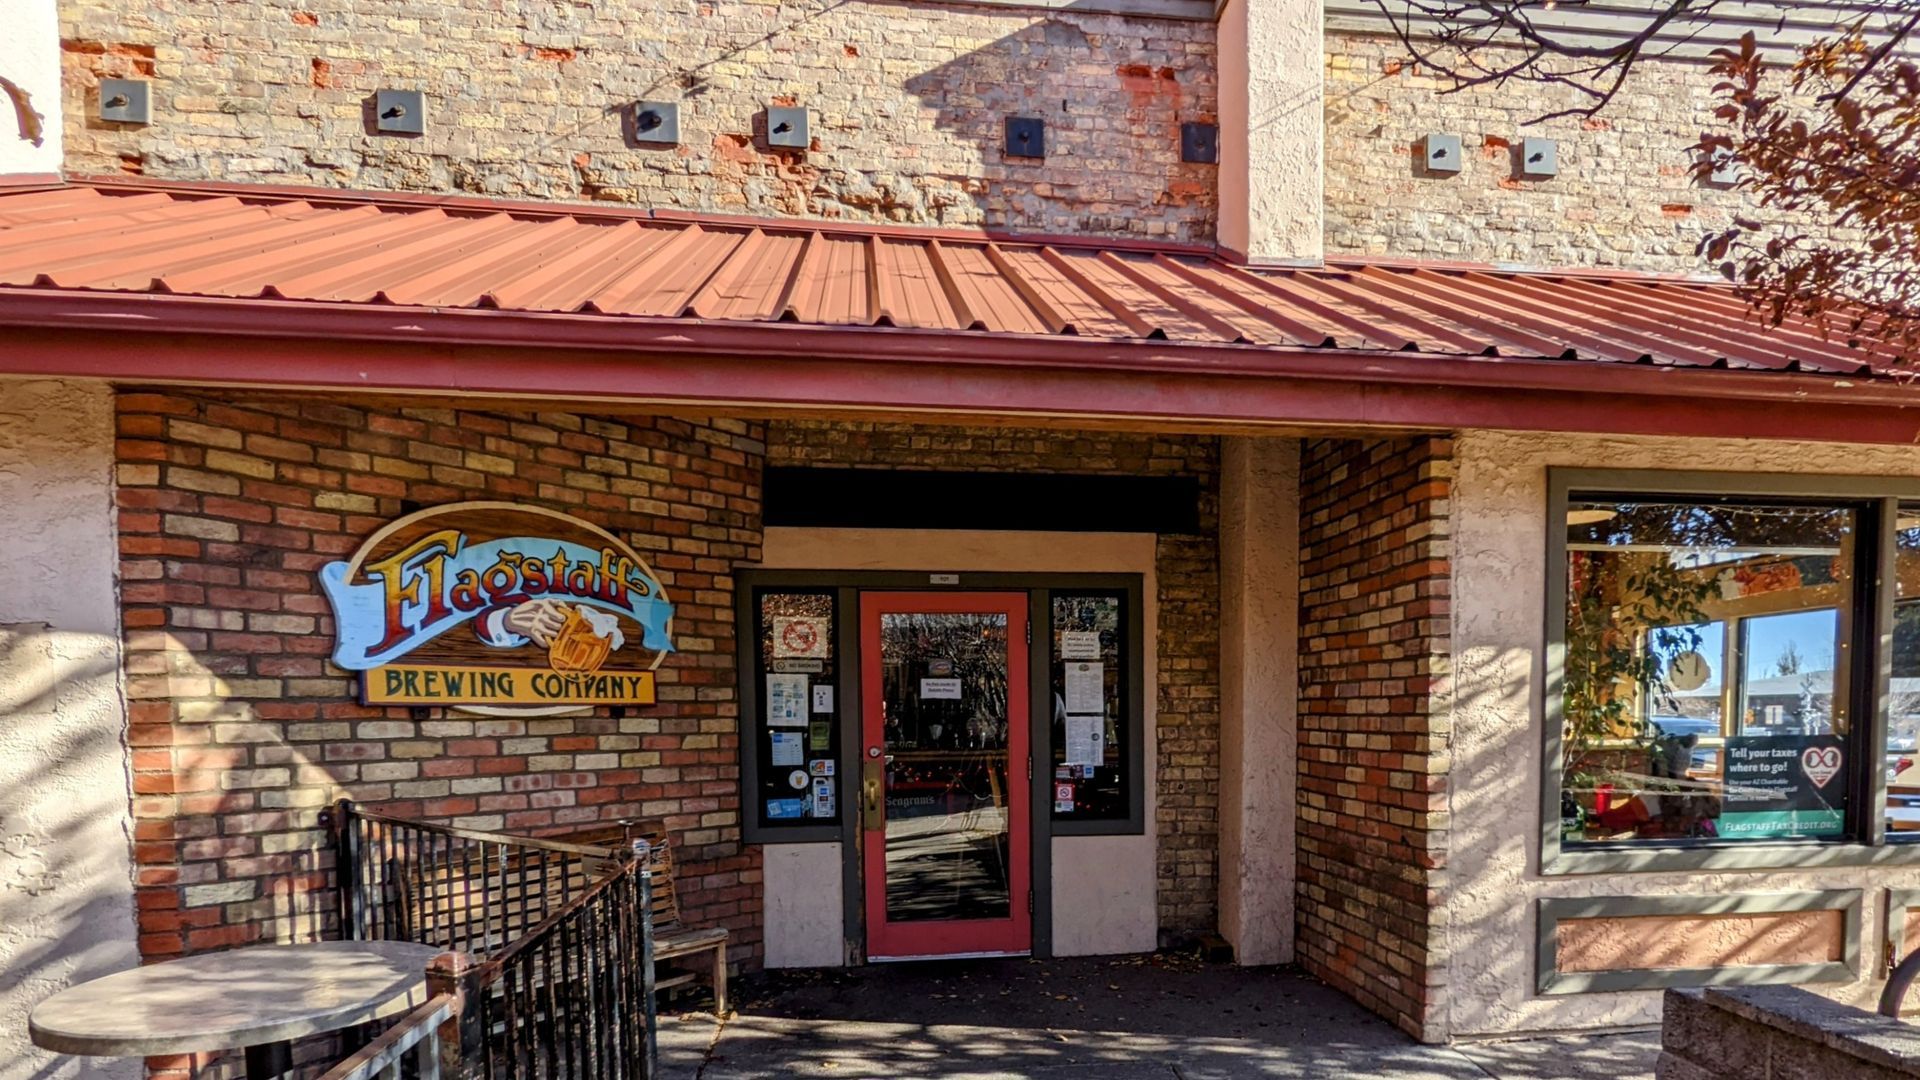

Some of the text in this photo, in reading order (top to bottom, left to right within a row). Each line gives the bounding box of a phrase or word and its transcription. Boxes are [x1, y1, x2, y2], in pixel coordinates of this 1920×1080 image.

[364, 529, 650, 658] Flagstaff
[385, 669, 643, 699] BREWING COMPANY
[1730, 748, 1798, 760] Tell your taxes
[1729, 761, 1788, 774] where to go!
